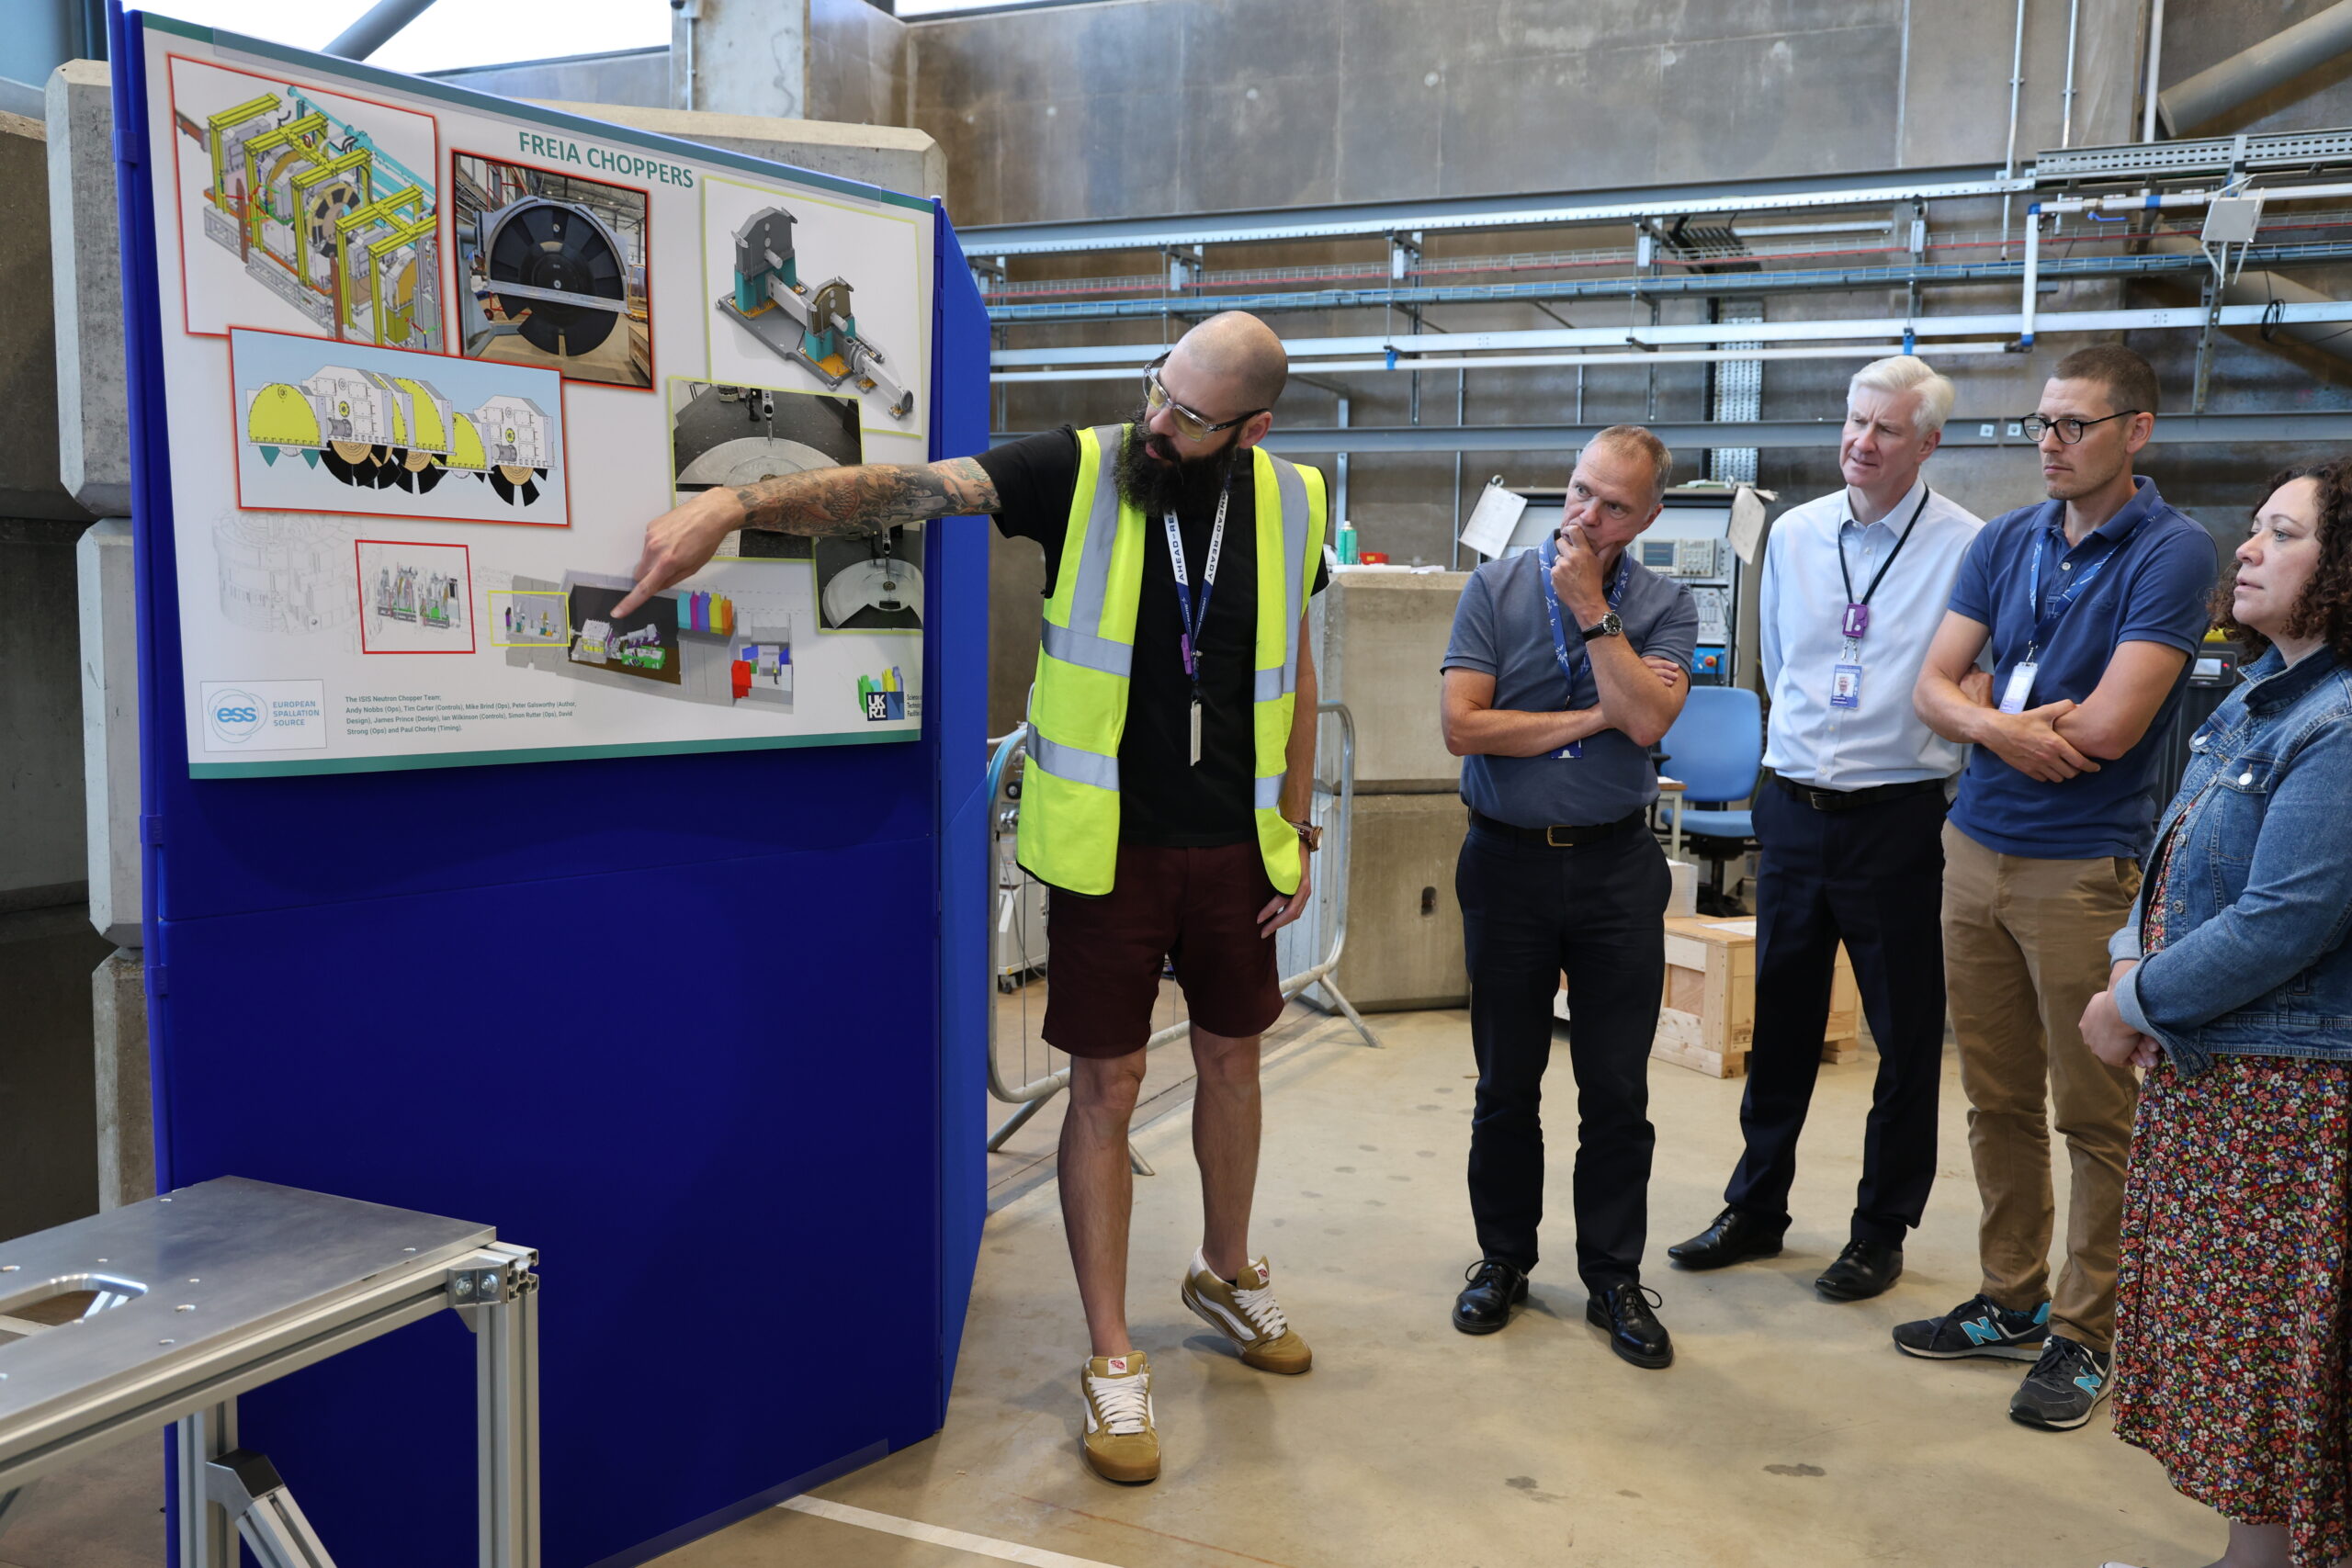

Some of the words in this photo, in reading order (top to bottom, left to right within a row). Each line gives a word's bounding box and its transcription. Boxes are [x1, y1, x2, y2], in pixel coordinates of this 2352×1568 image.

[518, 131, 582, 164] FREIA
[586, 148, 694, 188] CHOPPERS
[1172, 540, 1185, 581] AHEAD
[1207, 540, 1219, 580] READY
[273, 709, 320, 717] SPALLATION
[273, 718, 306, 727] SOURCE
[1960, 1315, 2002, 1346] N
